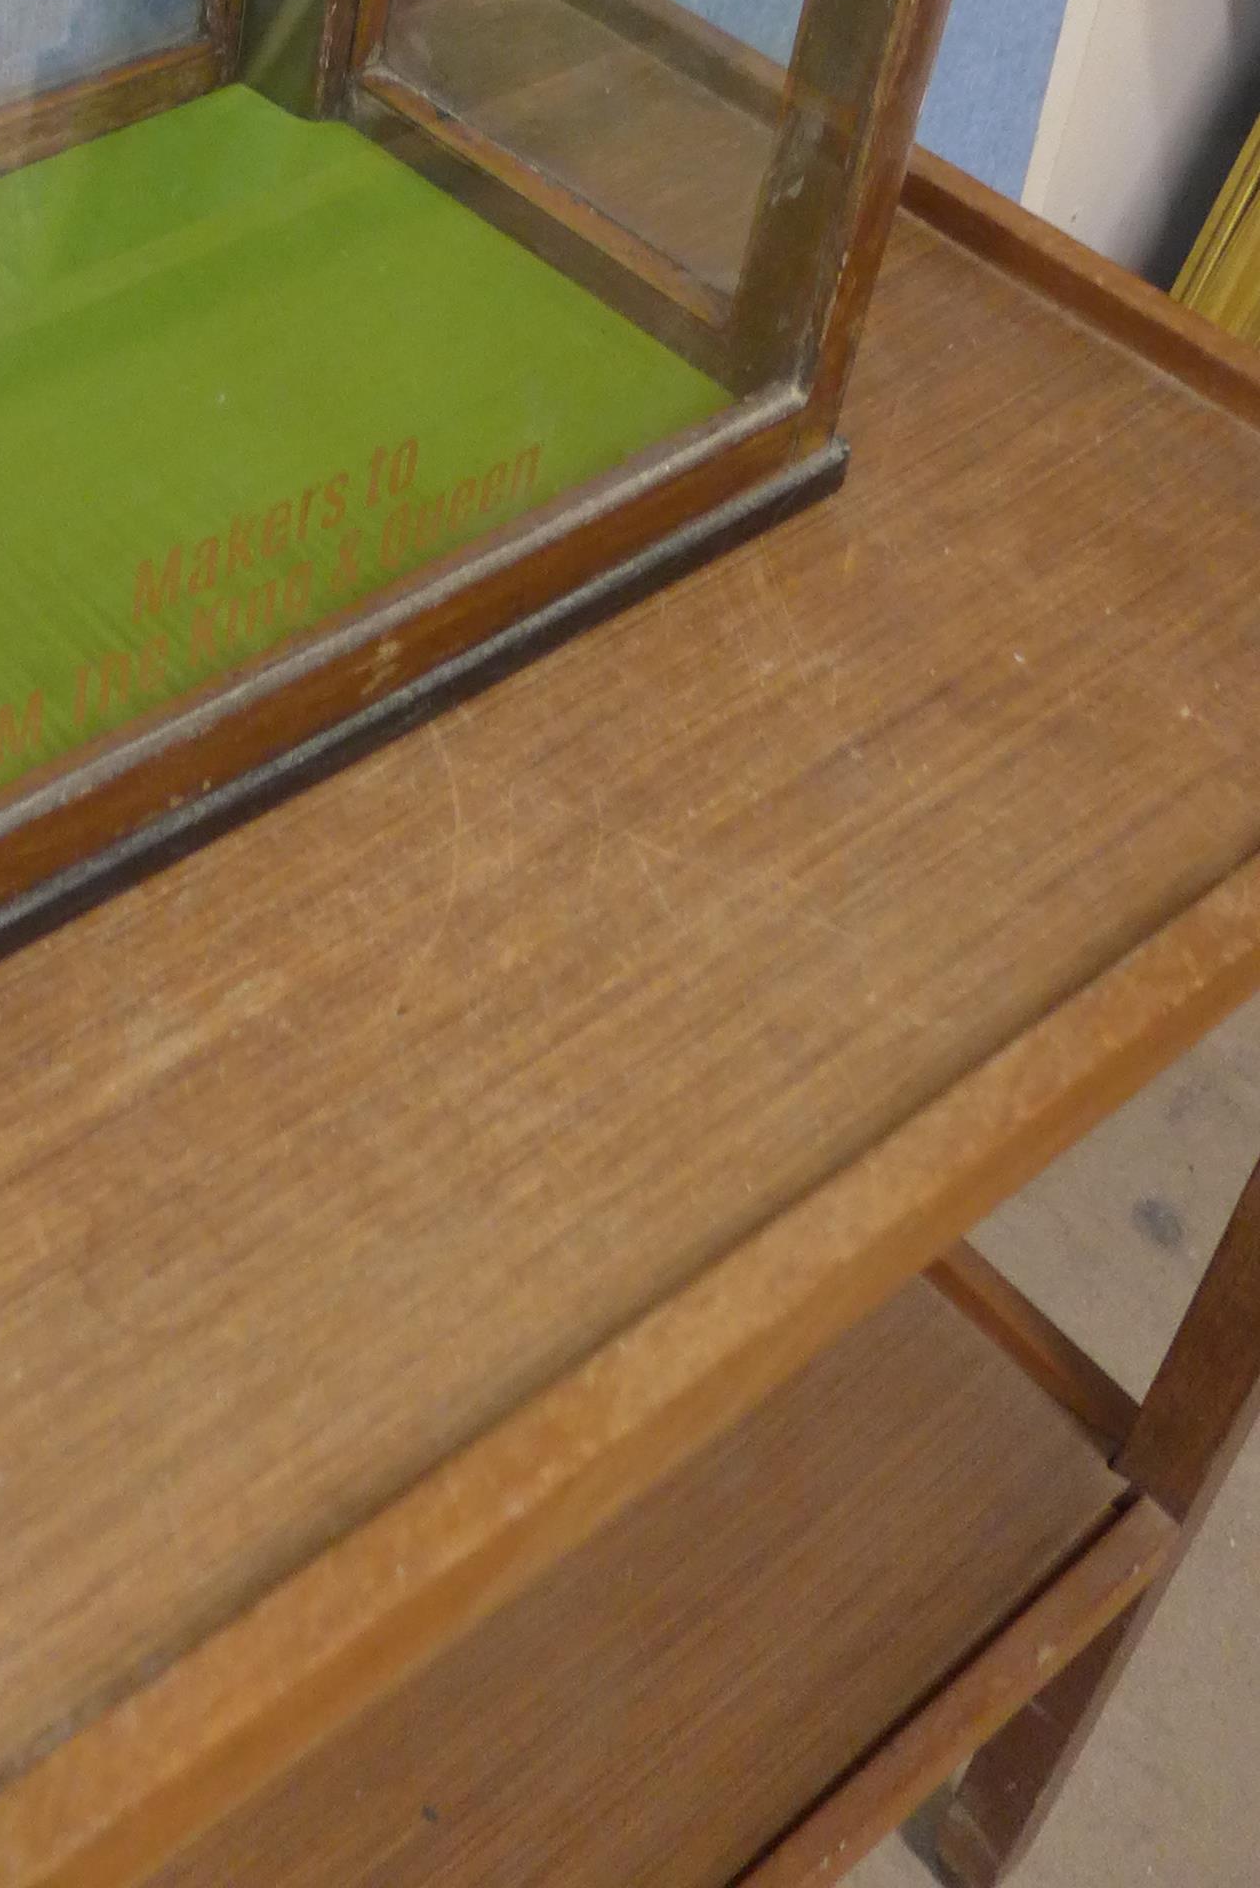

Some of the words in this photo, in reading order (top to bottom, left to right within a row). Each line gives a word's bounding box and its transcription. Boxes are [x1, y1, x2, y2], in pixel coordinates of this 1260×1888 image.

[132, 471, 349, 625] Makers
[367, 436, 418, 508] to
[380, 444, 543, 570] Queen
